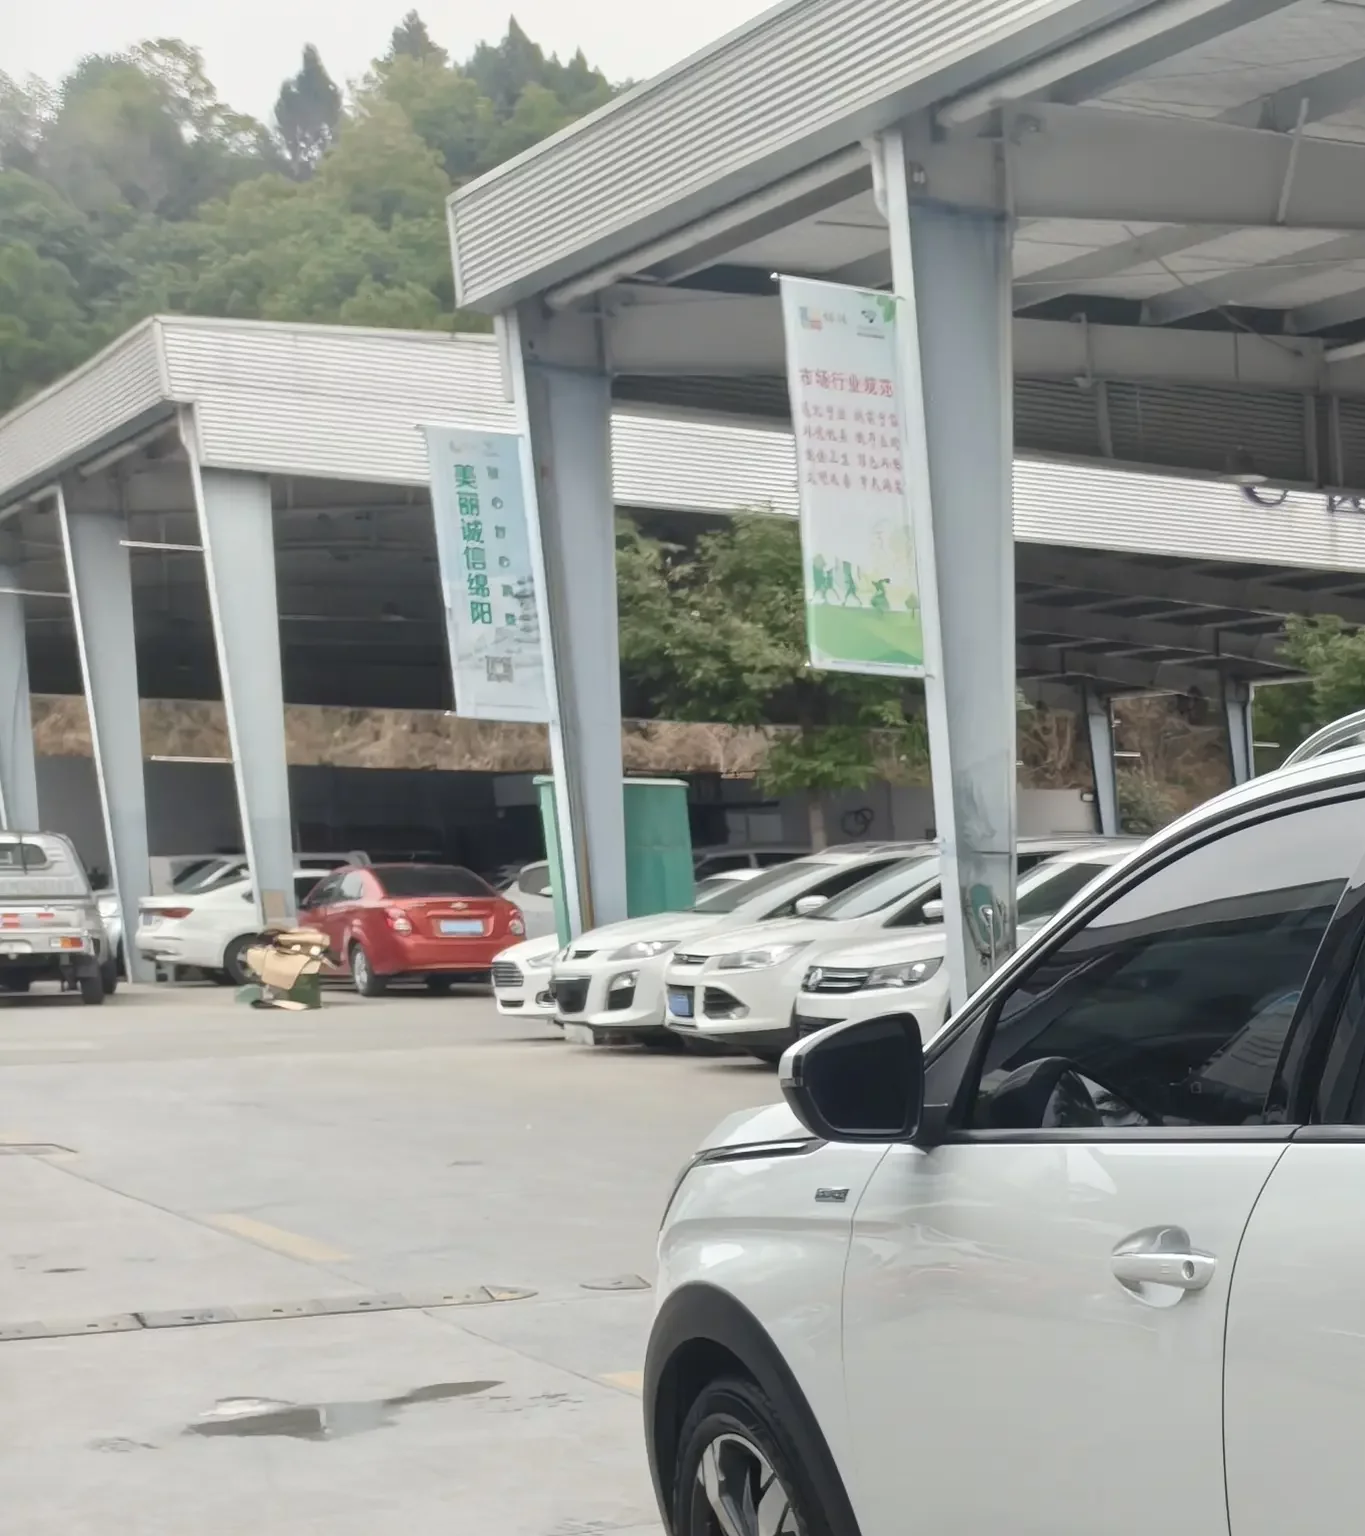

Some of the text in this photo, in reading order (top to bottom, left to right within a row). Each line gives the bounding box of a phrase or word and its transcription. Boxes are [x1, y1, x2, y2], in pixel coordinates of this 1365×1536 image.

[453, 464, 493, 624] 美丽诚信绵阳
